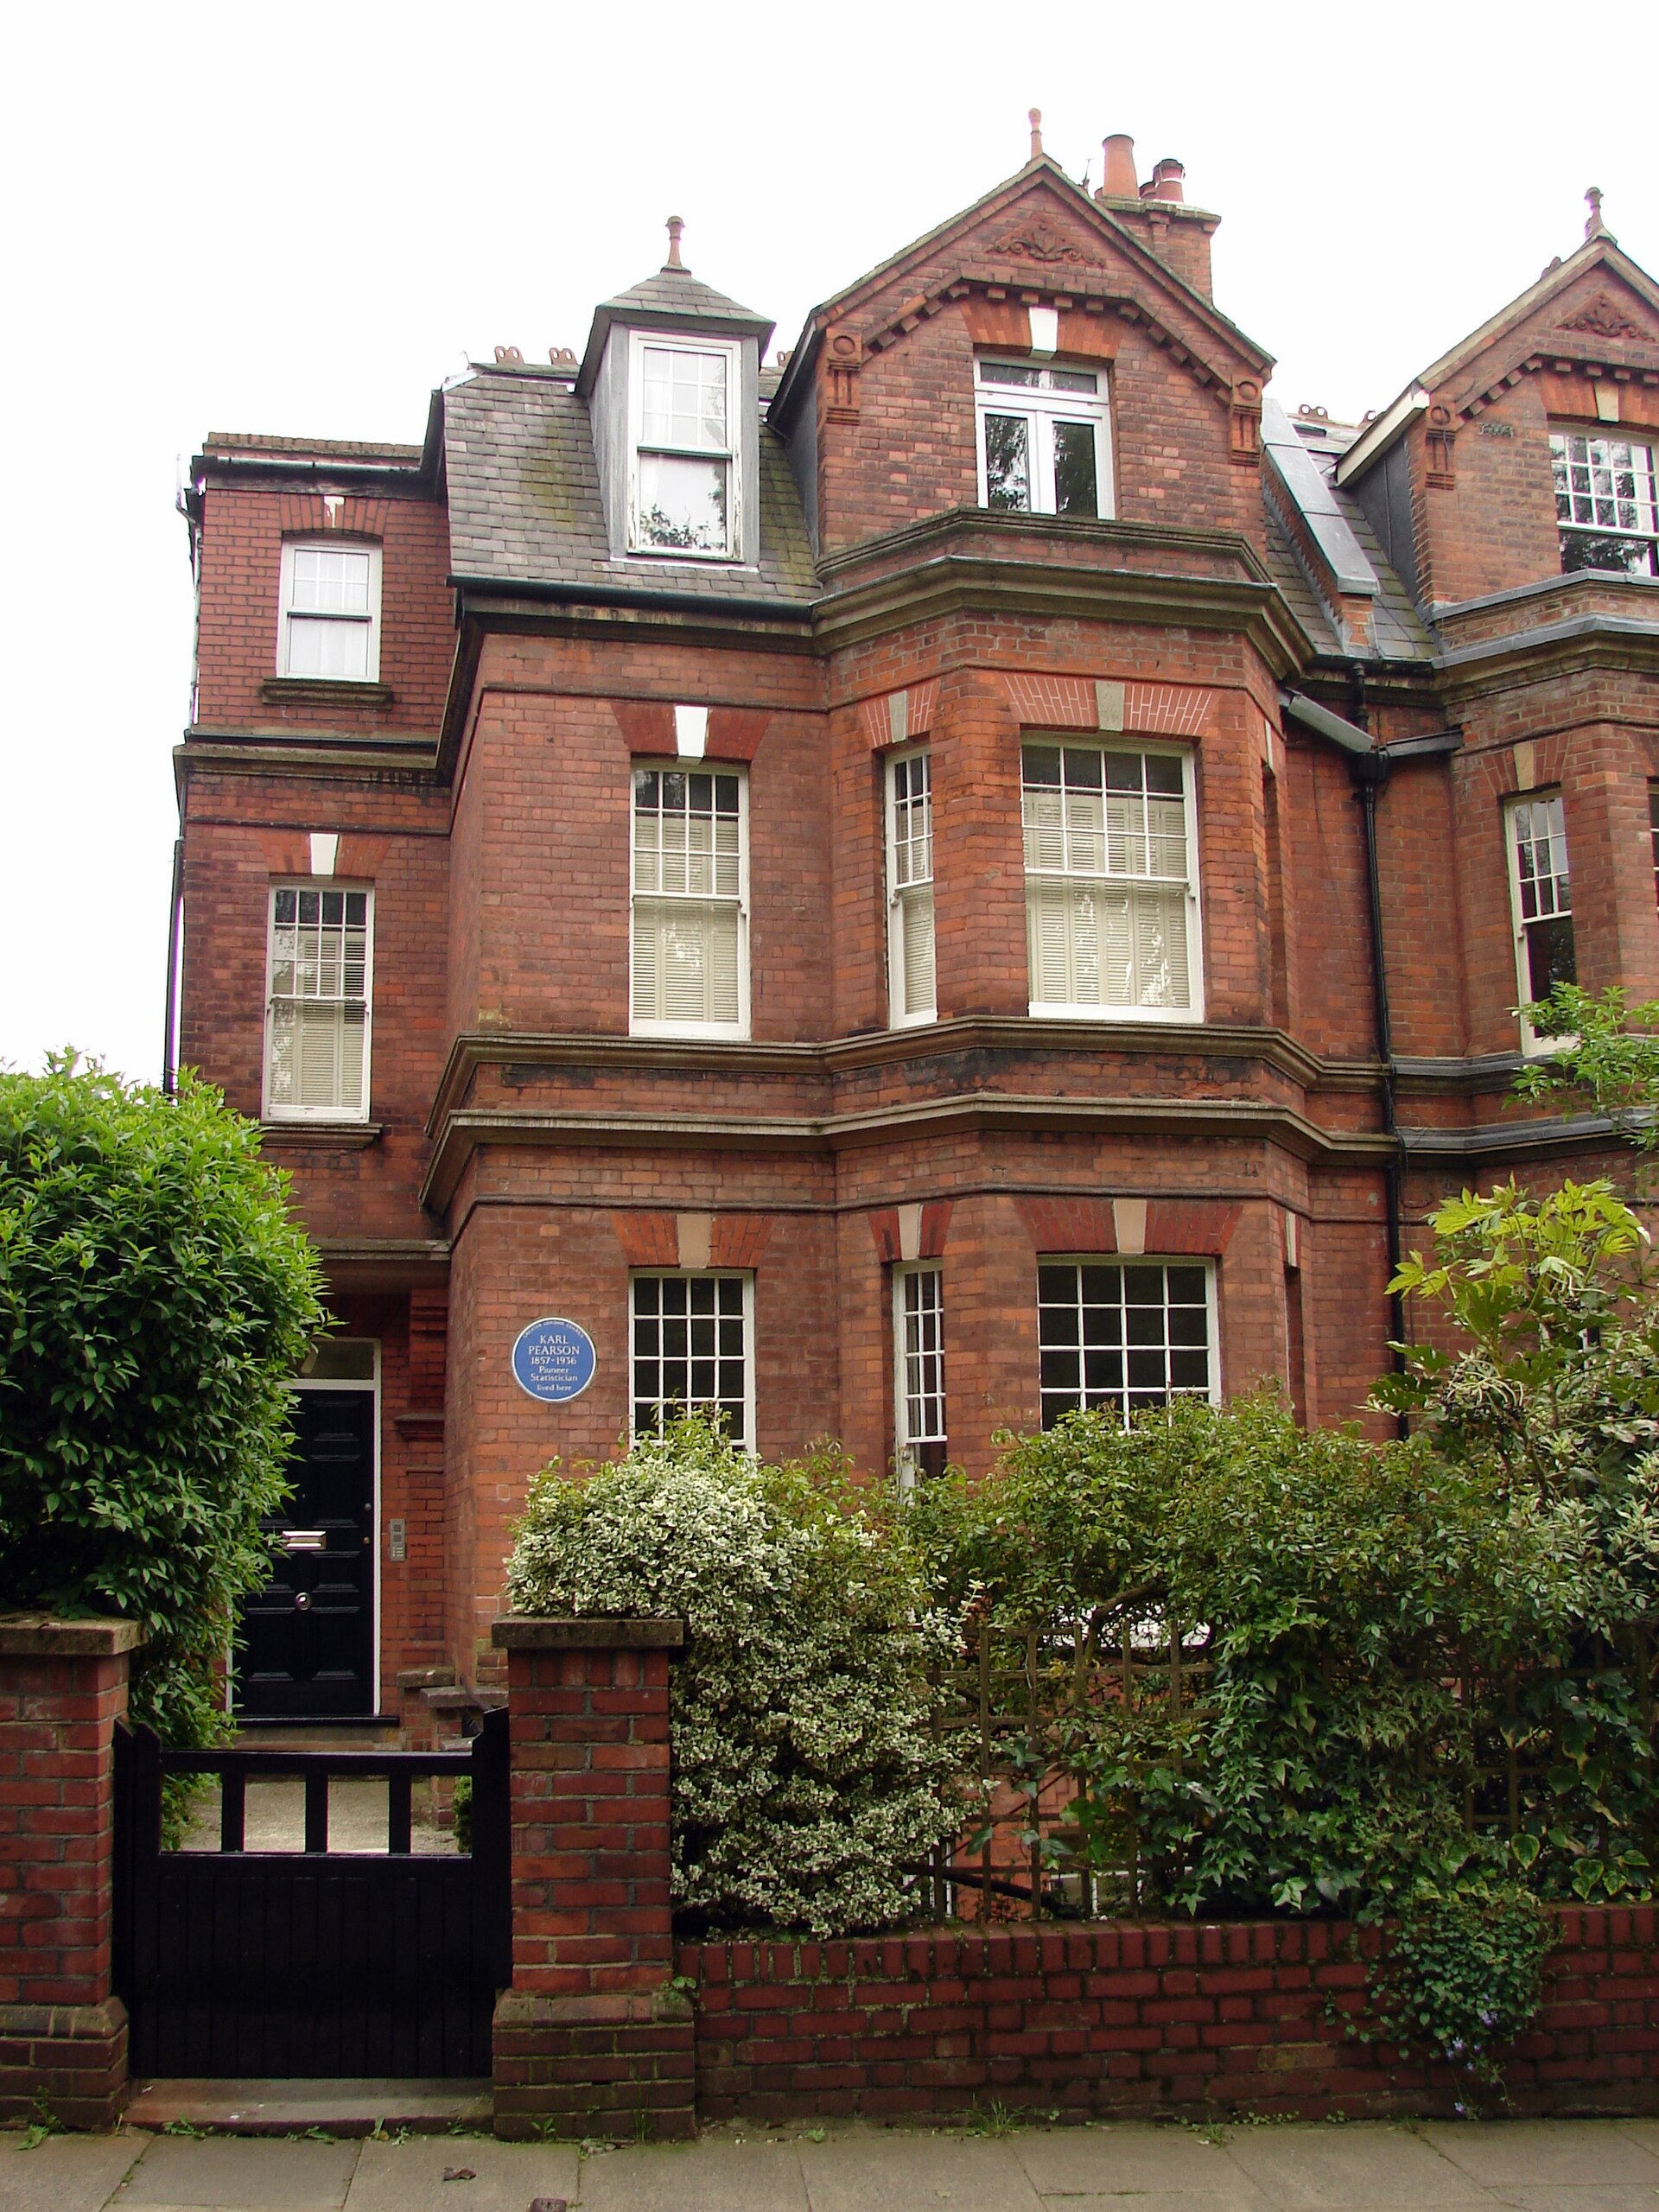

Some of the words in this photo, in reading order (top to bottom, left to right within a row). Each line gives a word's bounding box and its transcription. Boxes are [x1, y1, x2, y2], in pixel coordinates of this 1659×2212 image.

[539, 1334, 569, 1344] KARL
[528, 1345, 580, 1356] PEARSON
[538, 1365, 569, 1374] Pioneer
[531, 1373, 578, 1382] Statistician
